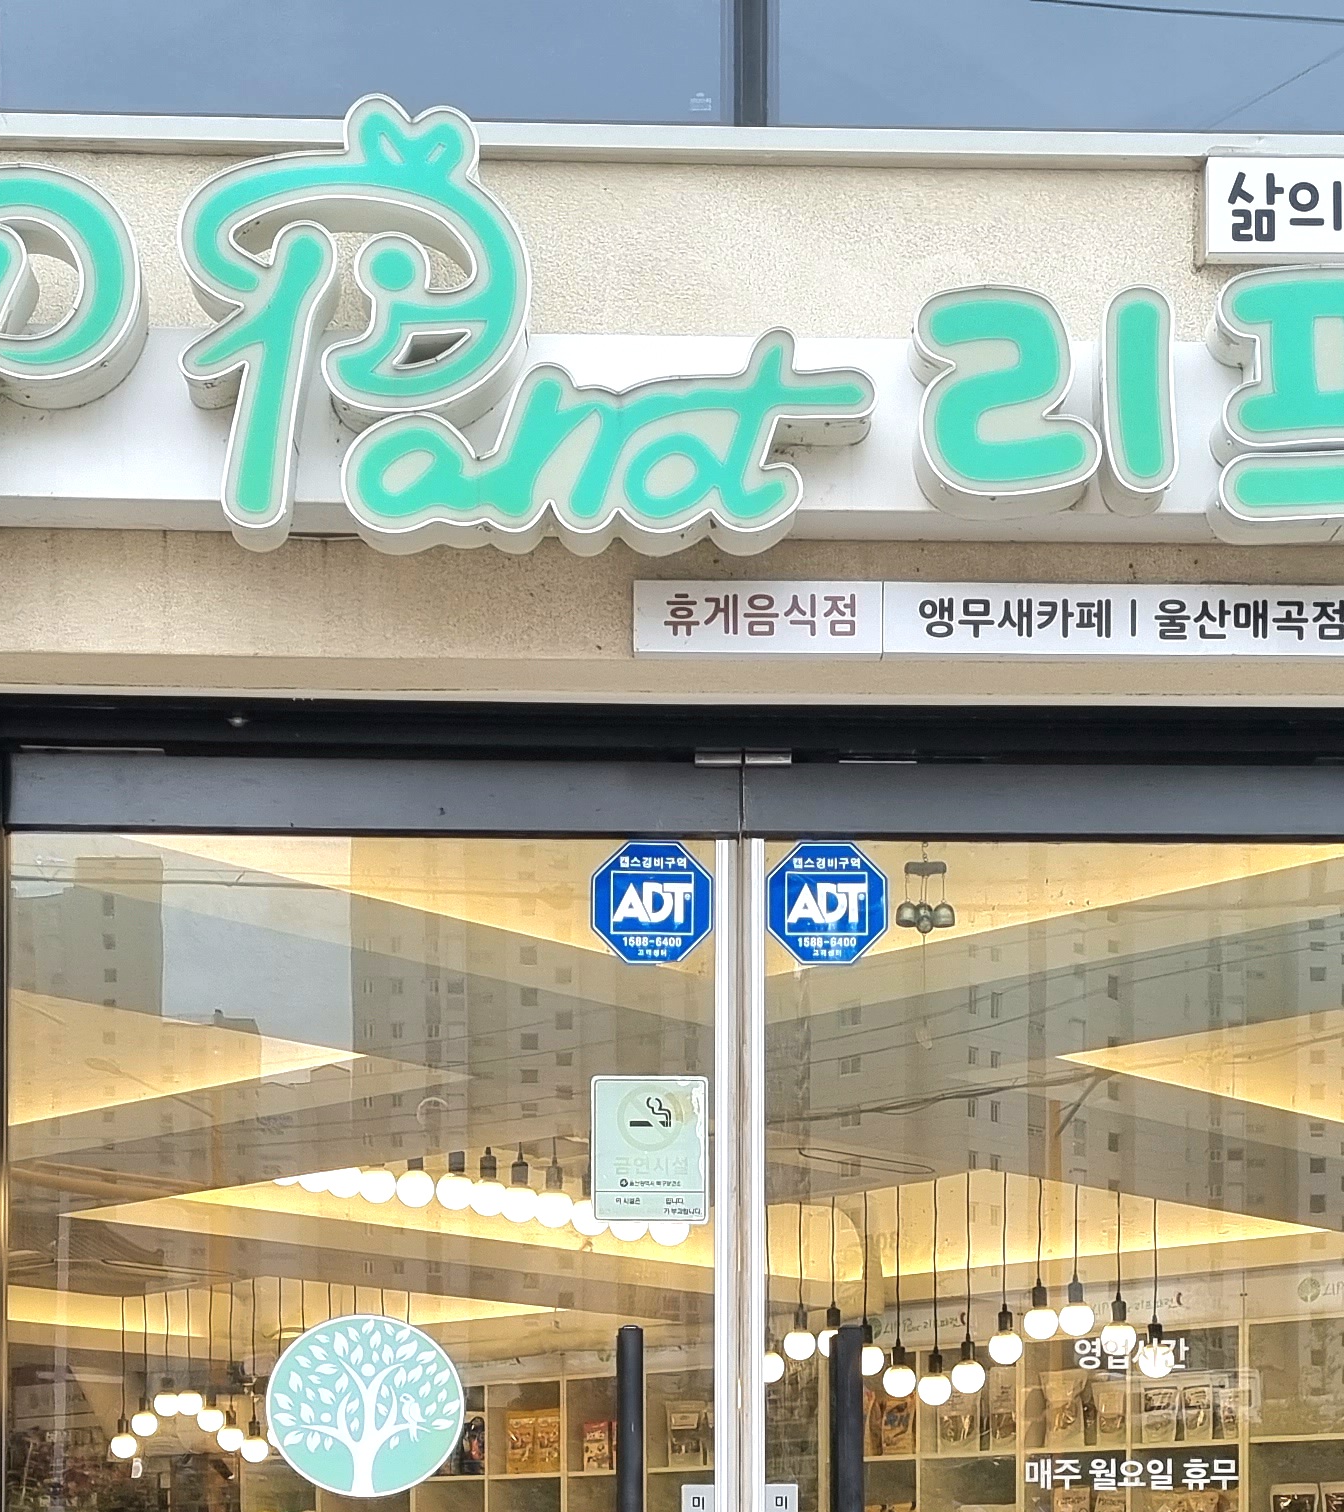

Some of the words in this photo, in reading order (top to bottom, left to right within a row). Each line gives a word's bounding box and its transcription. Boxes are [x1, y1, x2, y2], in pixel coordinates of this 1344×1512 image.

[1226, 182, 1344, 244] 삶의
[662, 592, 859, 637] 휴게음식점
[918, 597, 1114, 640] 앵무새카페
[792, 857, 861, 870] 캡스경비구역
[612, 881, 693, 923] ADT
[787, 882, 868, 924] ADT
[1025, 1458, 1082, 1489] 매주
[1089, 1458, 1173, 1491] 월요일
[1182, 1458, 1239, 1490] 휴무
